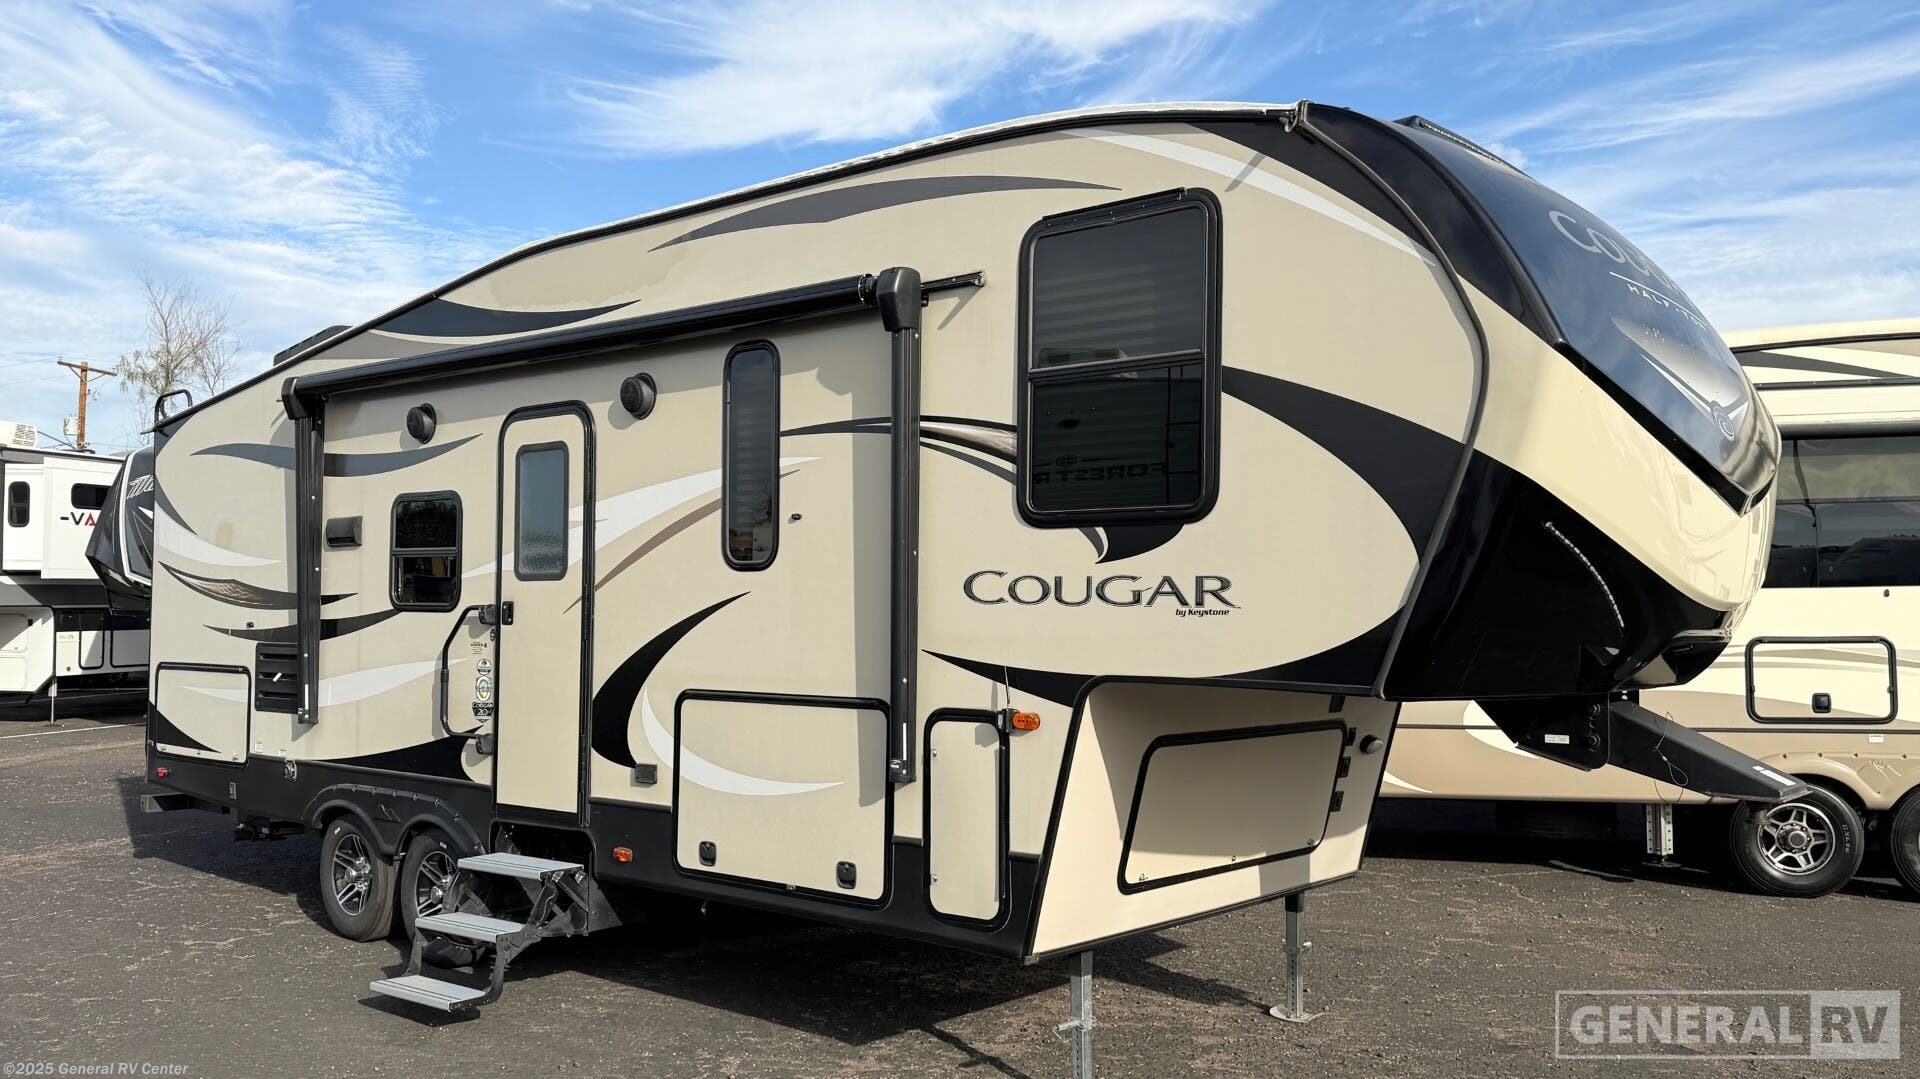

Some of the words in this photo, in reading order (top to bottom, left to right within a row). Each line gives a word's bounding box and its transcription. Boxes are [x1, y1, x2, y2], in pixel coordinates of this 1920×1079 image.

[963, 570, 1242, 609] COUGAR
[1175, 608, 1187, 618] by
[1188, 608, 1230, 618] Keystone
